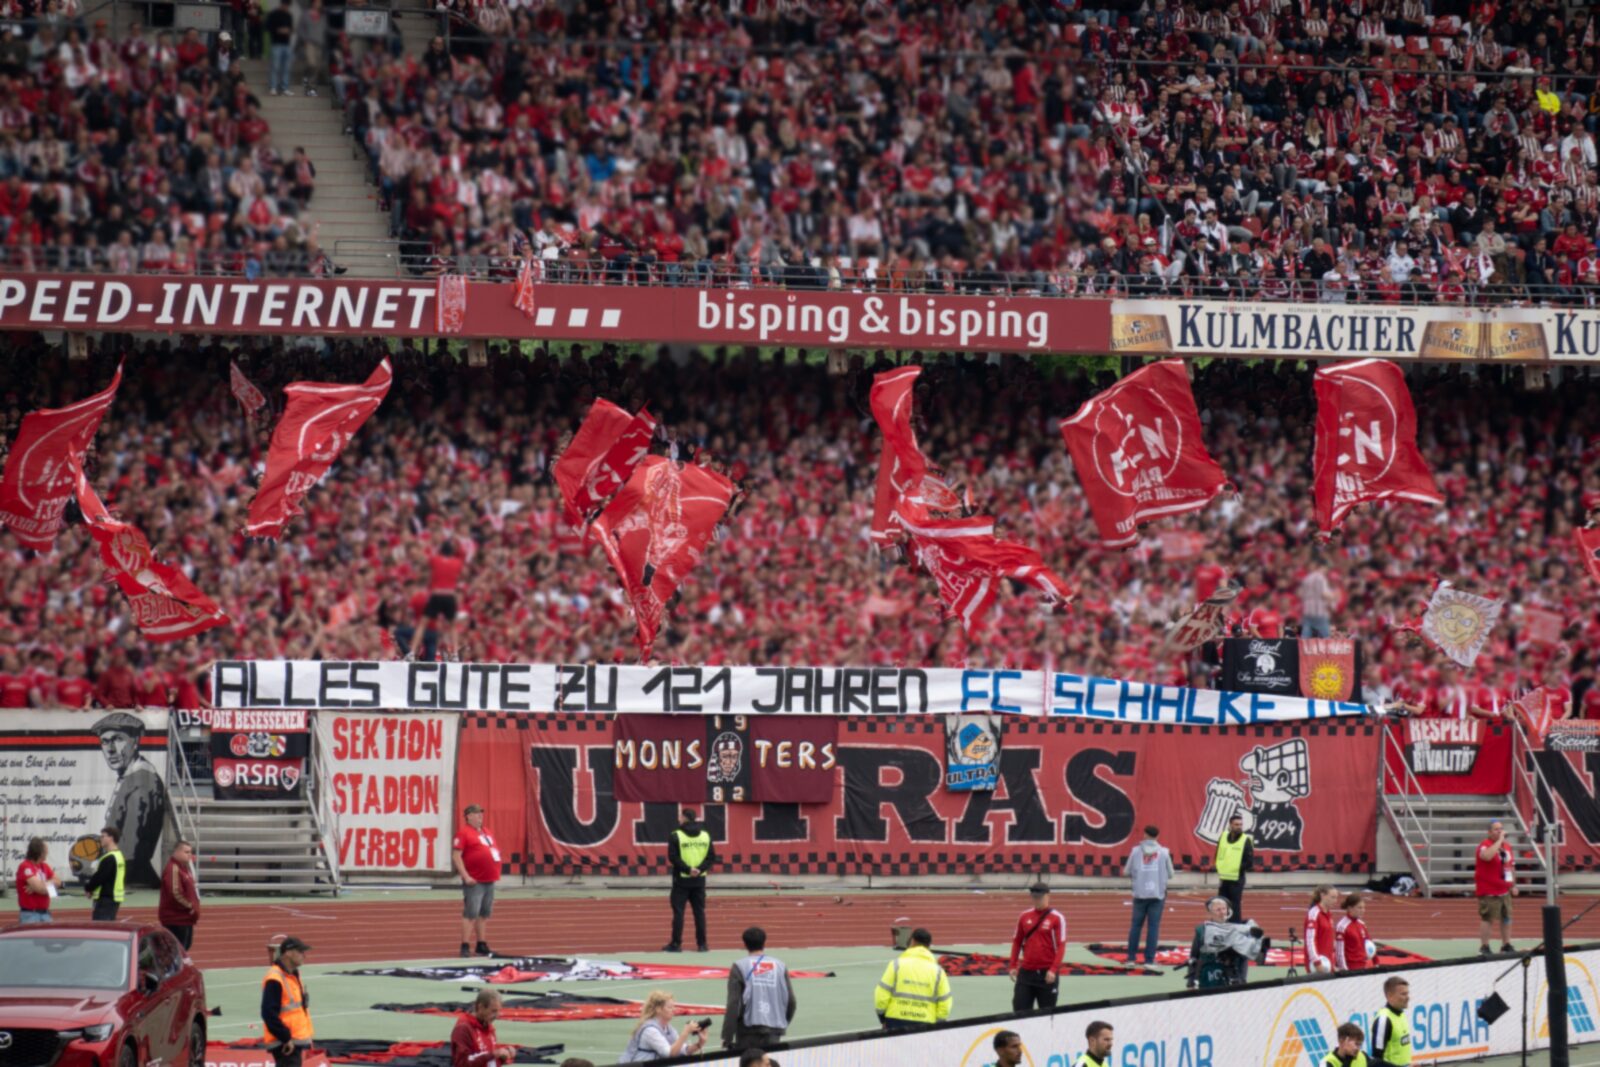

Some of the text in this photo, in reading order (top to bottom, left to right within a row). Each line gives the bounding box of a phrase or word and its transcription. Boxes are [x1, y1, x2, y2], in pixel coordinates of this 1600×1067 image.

[0, 279, 436, 328] PEED-INTERNET
[698, 290, 1049, 347] bisping & bisping
[1178, 304, 1415, 351] KULMBACHER
[214, 661, 380, 707] ALLES
[408, 662, 531, 709] GUTE
[554, 665, 618, 712] ZU
[642, 667, 731, 712] 121
[752, 666, 929, 714] JAHREN
[961, 670, 1022, 712] FC
[1054, 672, 1276, 725] SCHALKE
[178, 708, 213, 726] 030
[212, 710, 306, 730] DIE BESESSENEN
[1409, 718, 1479, 742] RESPEKT
[333, 716, 443, 761] SEKTION
[615, 739, 836, 770] MONS TERS
[1412, 746, 1477, 773] RIVALITÄT
[235, 763, 279, 786] RSR
[332, 773, 439, 815] STADION
[712, 786, 746, 802] 82
[1259, 820, 1296, 841] 1994
[338, 827, 439, 869] VERBOT
